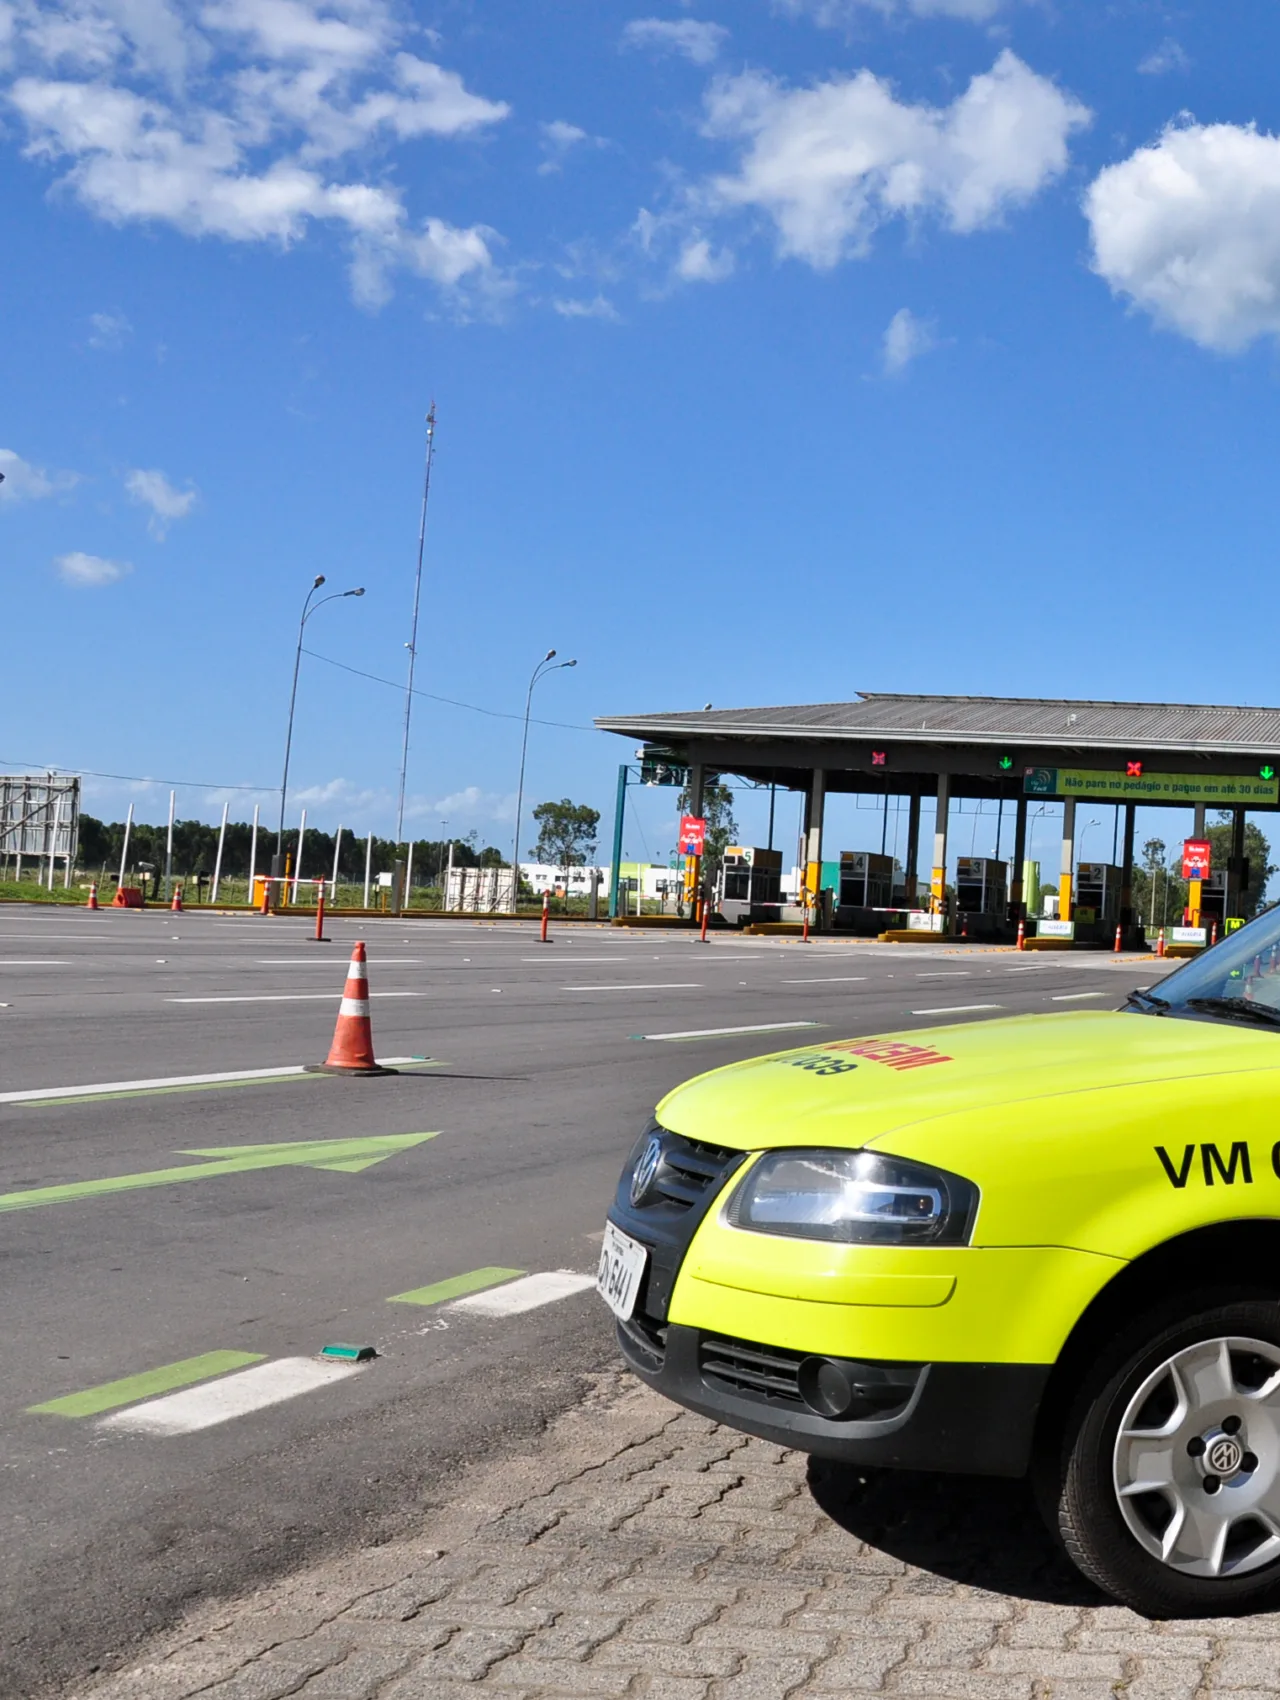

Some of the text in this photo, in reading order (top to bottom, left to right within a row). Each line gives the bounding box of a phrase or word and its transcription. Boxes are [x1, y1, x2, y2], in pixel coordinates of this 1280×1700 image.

[1065, 776, 1083, 787] Não
[1086, 780, 1106, 790] pare
[1109, 782, 1121, 790] no
[1123, 781, 1162, 793] pedágio
[1172, 784, 1201, 795] pague
[1221, 783, 1236, 793] até
[1239, 784, 1251, 794] 30
[1253, 785, 1274, 795] dias
[744, 851, 752, 863] 5
[856, 856, 863, 869] 4
[973, 861, 981, 874] 3
[1094, 867, 1101, 879] 2
[1216, 873, 1222, 885] 1
[1153, 1141, 1253, 1189] VM
